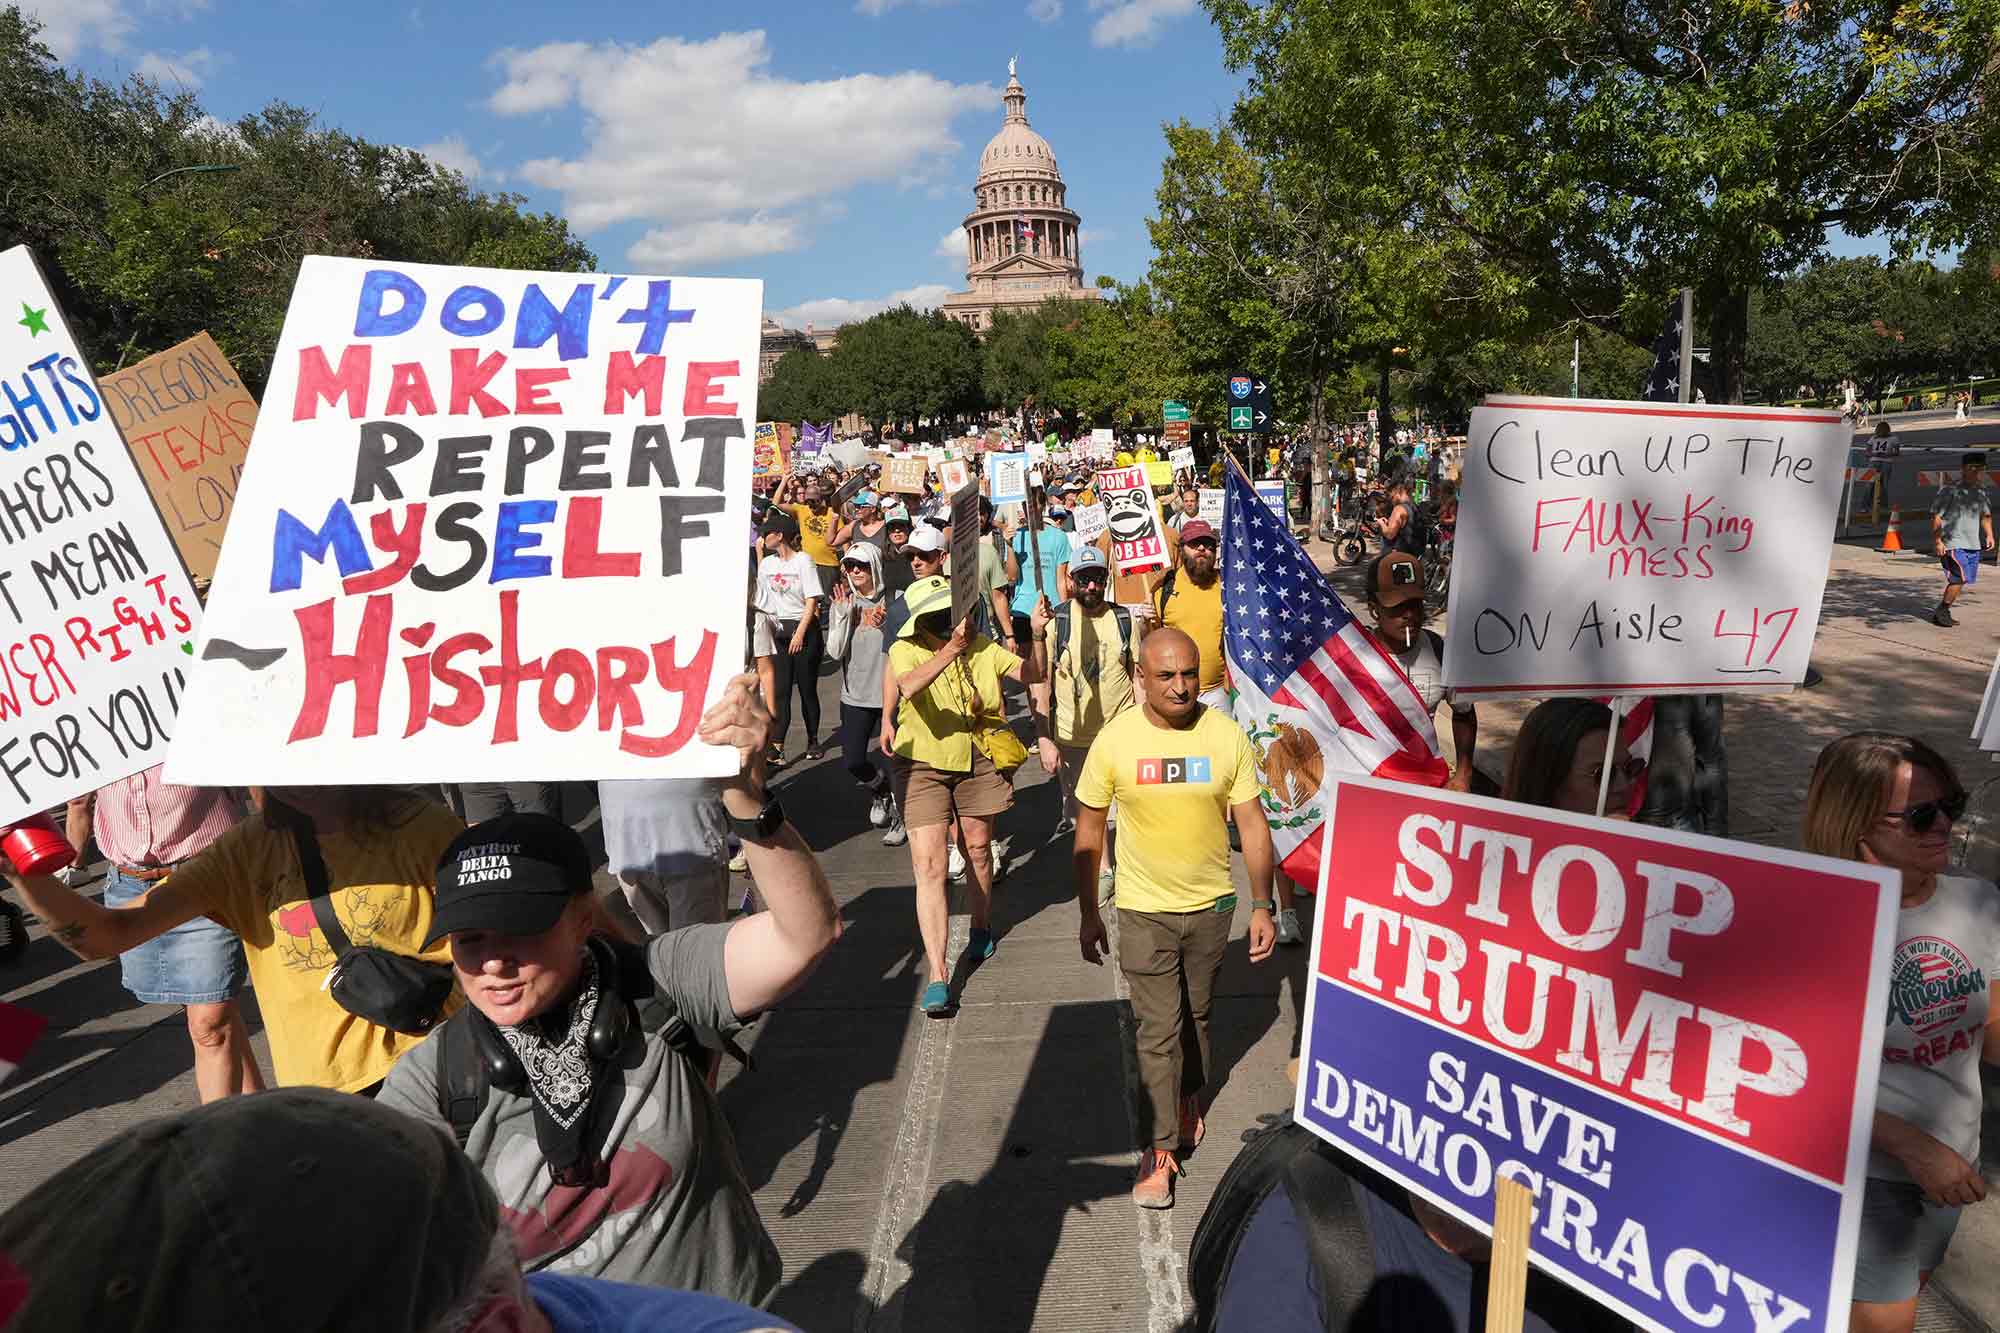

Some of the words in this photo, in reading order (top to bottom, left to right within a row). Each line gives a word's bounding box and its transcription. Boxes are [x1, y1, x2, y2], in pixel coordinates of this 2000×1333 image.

[292, 344, 571, 421] MAKE
[604, 350, 740, 416] ME
[1233, 382, 1249, 395] 35
[351, 417, 745, 503] REPEAT
[1486, 420, 1625, 484] Clean
[1727, 436, 1815, 484] The
[1876, 441, 1887, 451] 14
[167, 464, 244, 531] LOV
[1100, 470, 1140, 489] DON'T
[31, 521, 148, 610] MEAN
[1114, 538, 1158, 560] OBEY
[64, 574, 192, 662] RIGHTS
[1474, 608, 1552, 655] ON
[1568, 600, 1683, 652] Aisle
[1714, 607, 1800, 667] 47
[0, 731, 99, 804] FOR
[1143, 763, 1203, 781] npr
[456, 841, 521, 862] FOXTROT
[457, 867, 513, 887] TANGO
[460, 855, 510, 873] DELTA
[1392, 812, 1735, 978] STOP
[1908, 941, 1939, 954] WON'T
[1940, 947, 1968, 974] MAKE
[1343, 896, 1809, 1138] TRUMP
[1426, 1050, 1617, 1189] SAVE
